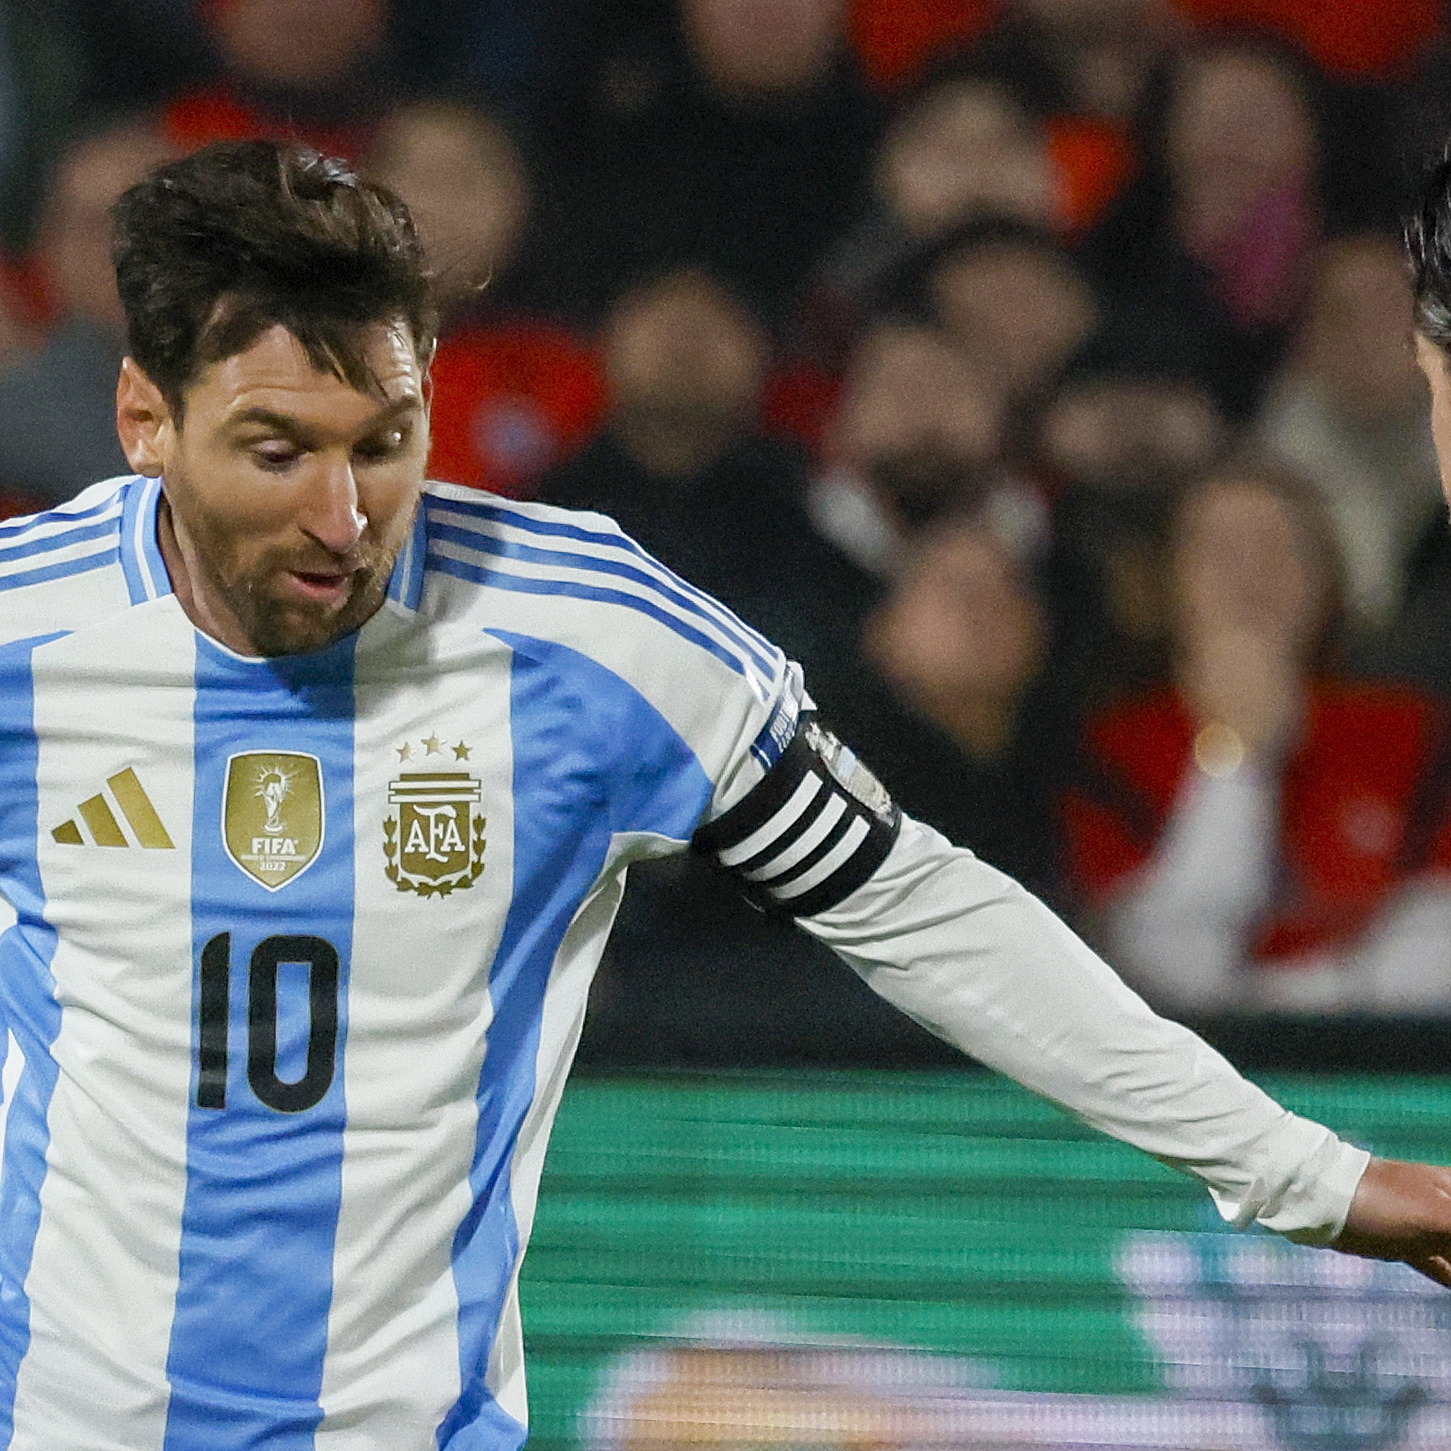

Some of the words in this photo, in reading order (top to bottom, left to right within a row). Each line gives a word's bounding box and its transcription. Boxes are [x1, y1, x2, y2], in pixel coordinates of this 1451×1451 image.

[251, 837, 297, 855] FIFA
[404, 804, 466, 863] AFA
[259, 861, 287, 871] 2022
[195, 930, 339, 1114] 10
